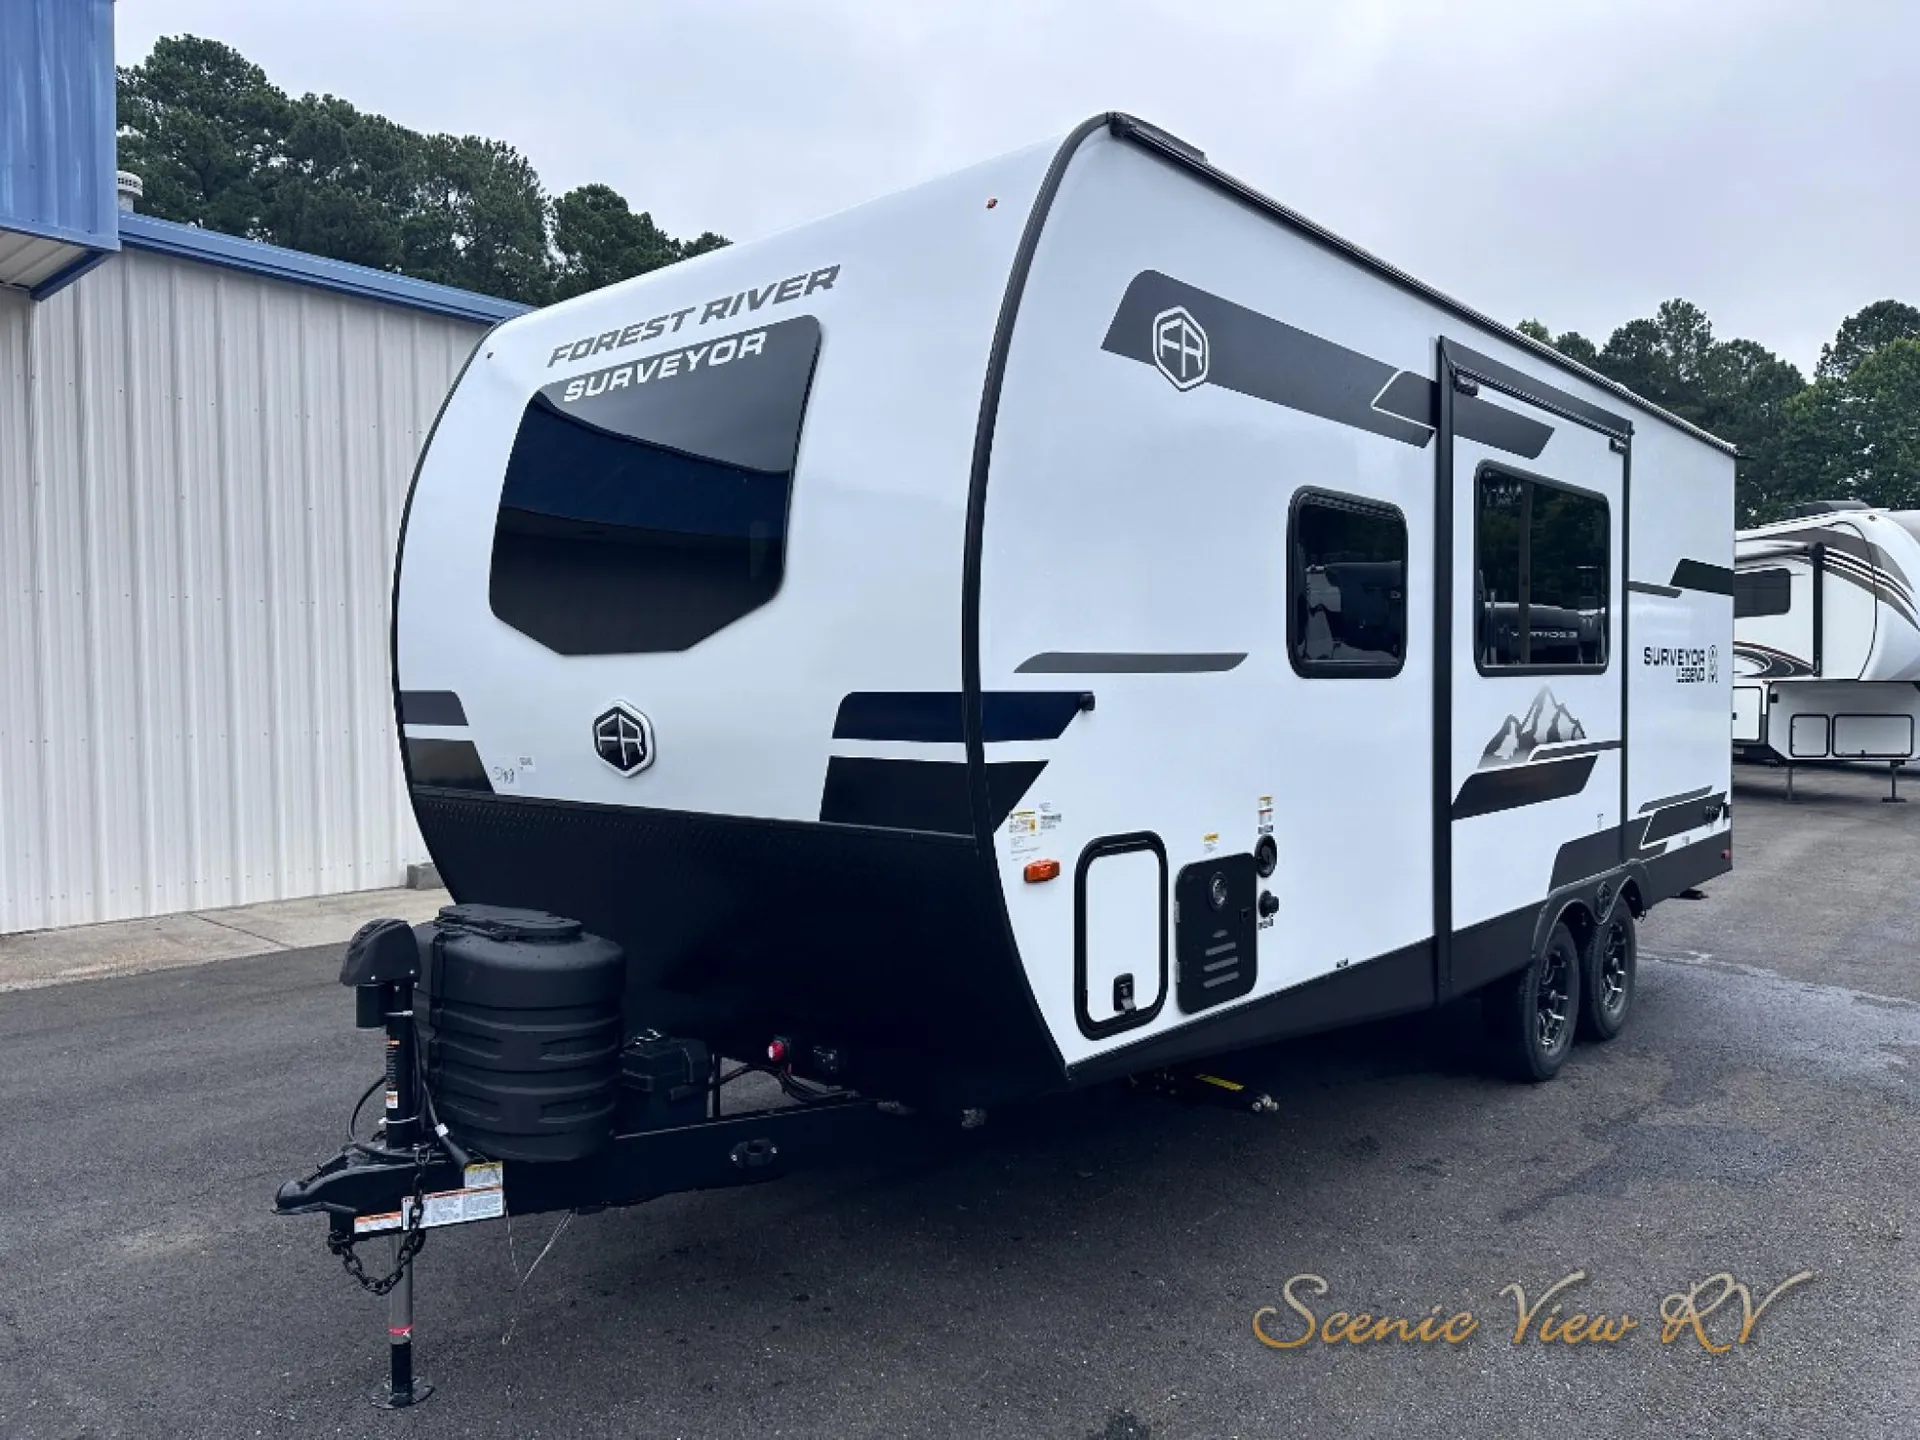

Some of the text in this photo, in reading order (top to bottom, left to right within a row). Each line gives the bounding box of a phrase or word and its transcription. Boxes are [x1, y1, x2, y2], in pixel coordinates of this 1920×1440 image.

[547, 264, 841, 368] FOREST RIVER
[564, 331, 768, 402] SURVEYOR
[1644, 646, 1705, 667] SURVEYOR
